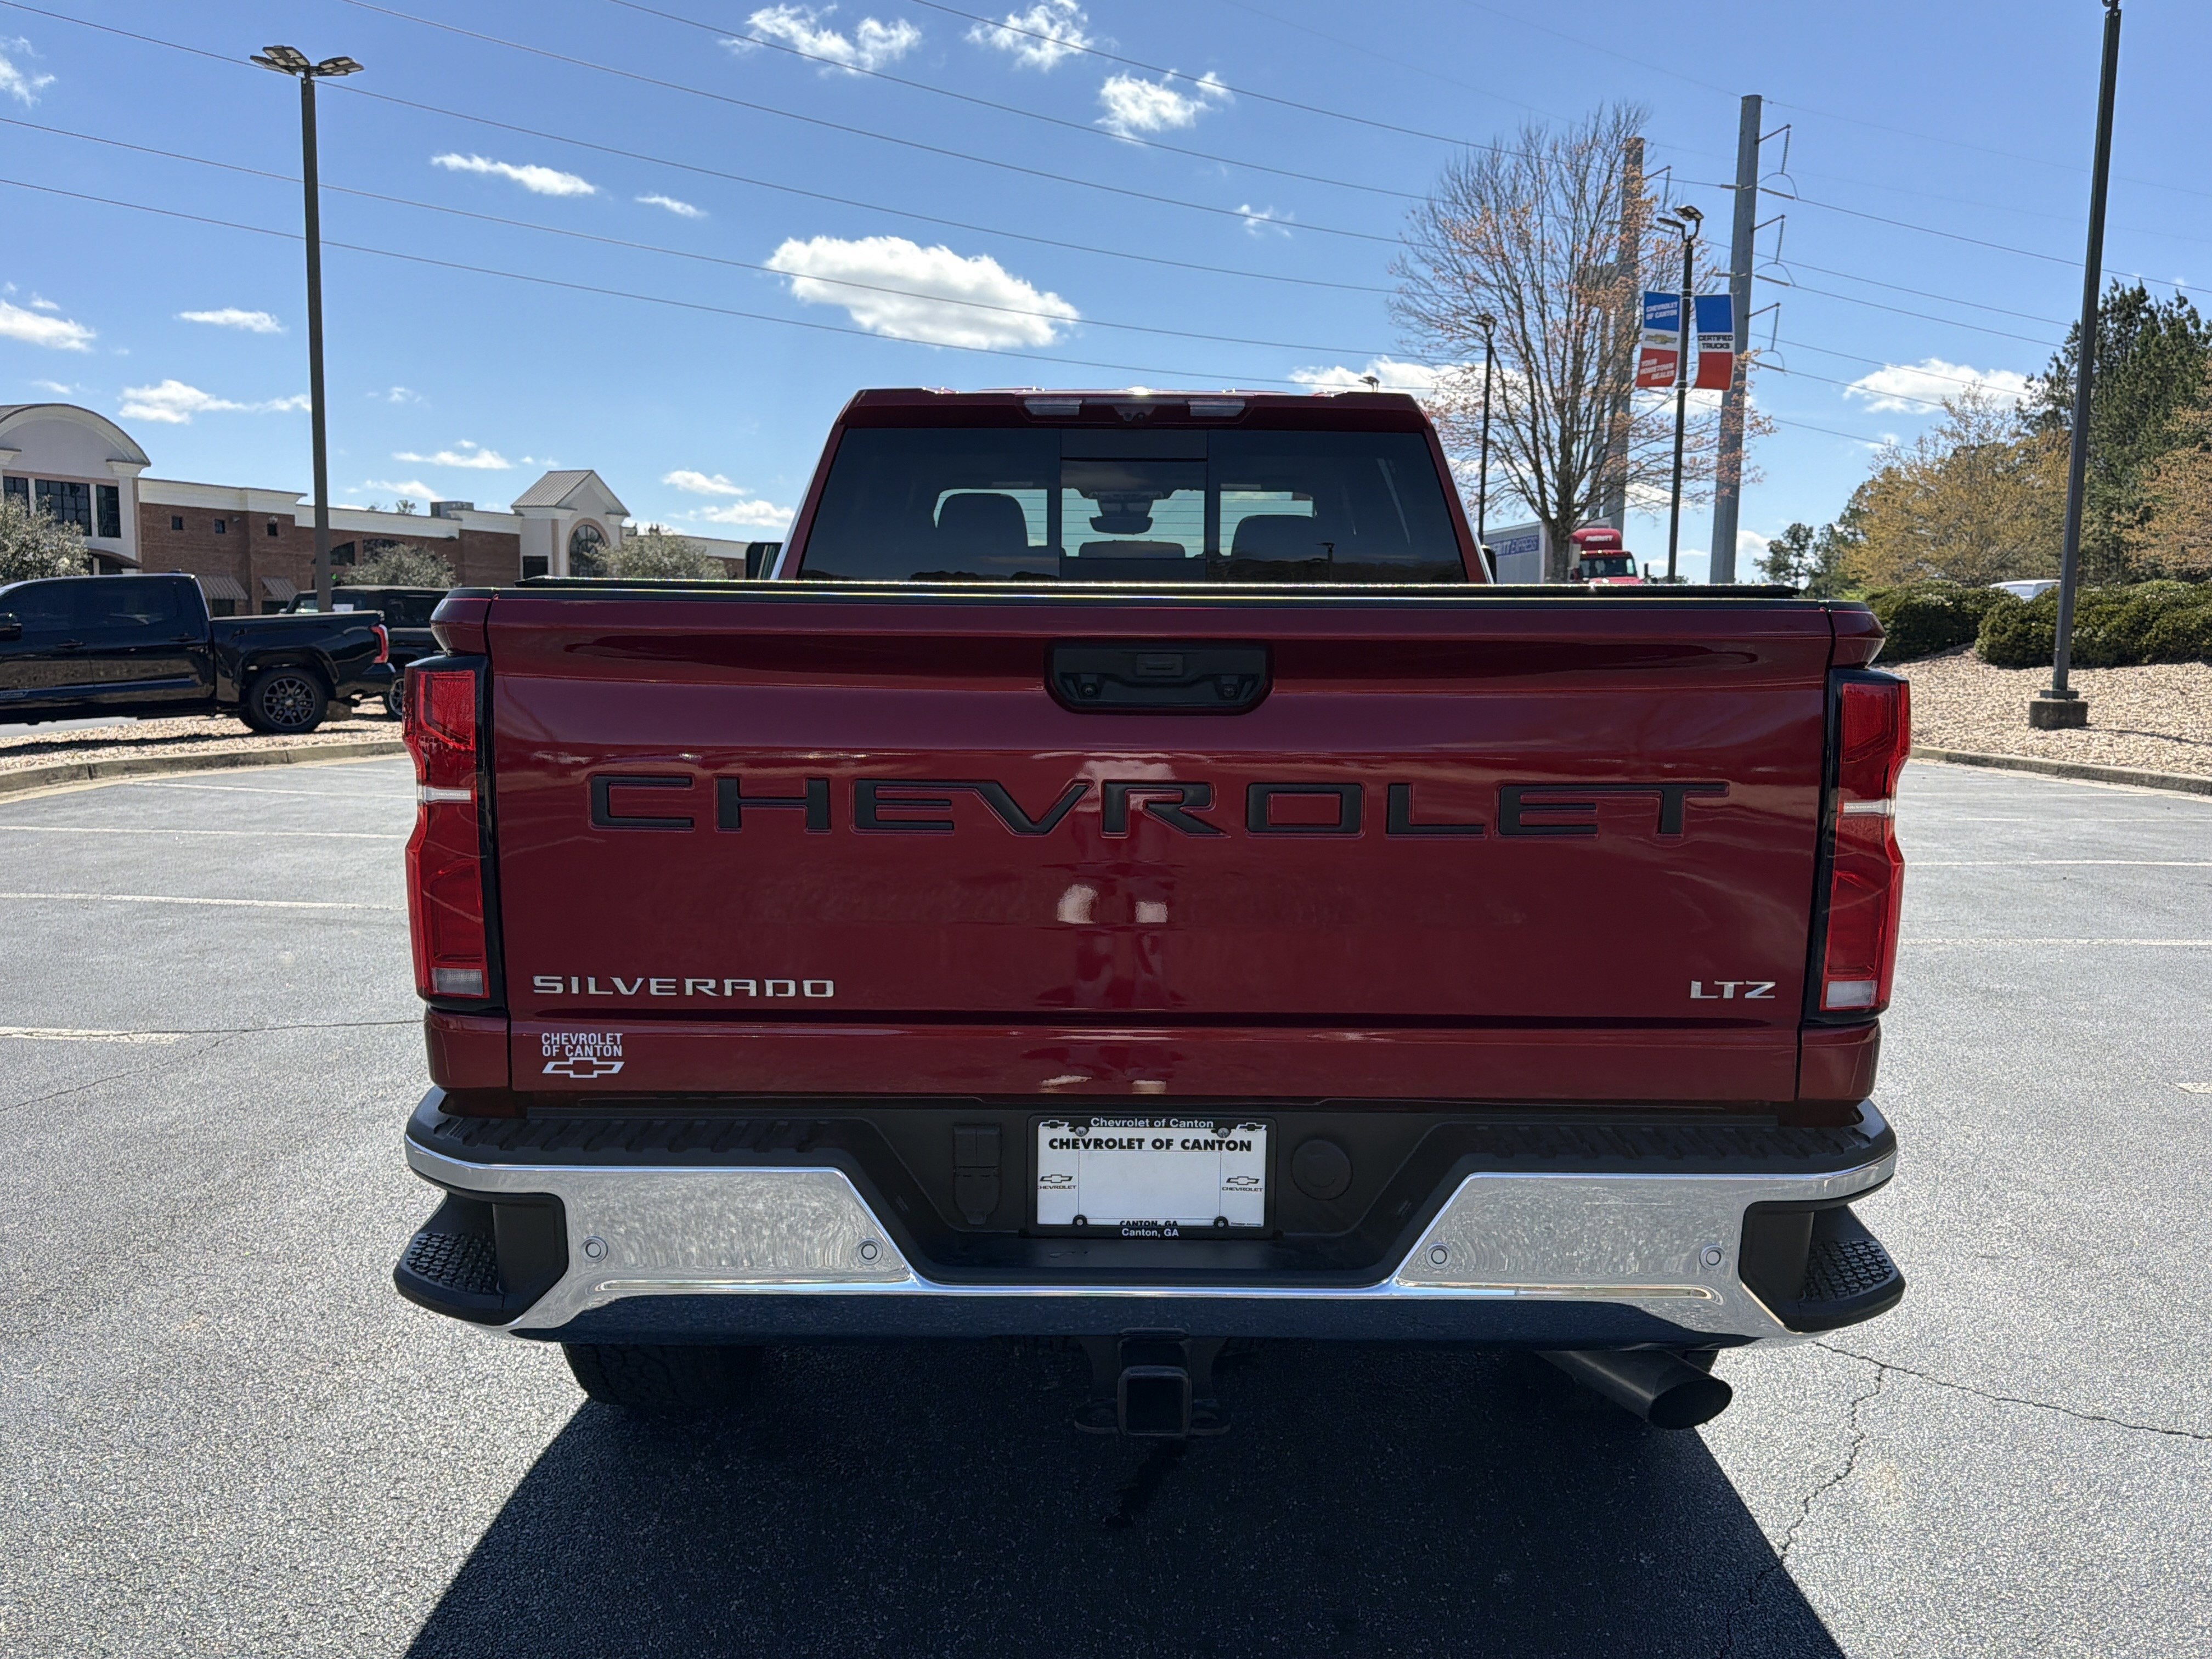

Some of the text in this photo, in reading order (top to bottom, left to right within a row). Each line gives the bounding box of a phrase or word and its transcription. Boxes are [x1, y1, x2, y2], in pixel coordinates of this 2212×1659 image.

[1511, 537, 1537, 554] EXPRESS
[589, 774, 1729, 837] CHEVROLET
[533, 975, 835, 997] SILVERADO
[1690, 980, 1776, 1000] LTZ
[541, 1033, 623, 1045] CHEVROLET
[542, 1045, 623, 1057] OF CANTON
[1091, 1117, 1214, 1128] Chevrolet of Canton
[1048, 1138, 1252, 1152] CHEVROLET OF CANTON
[1121, 1228, 1179, 1238] Canton, GA
